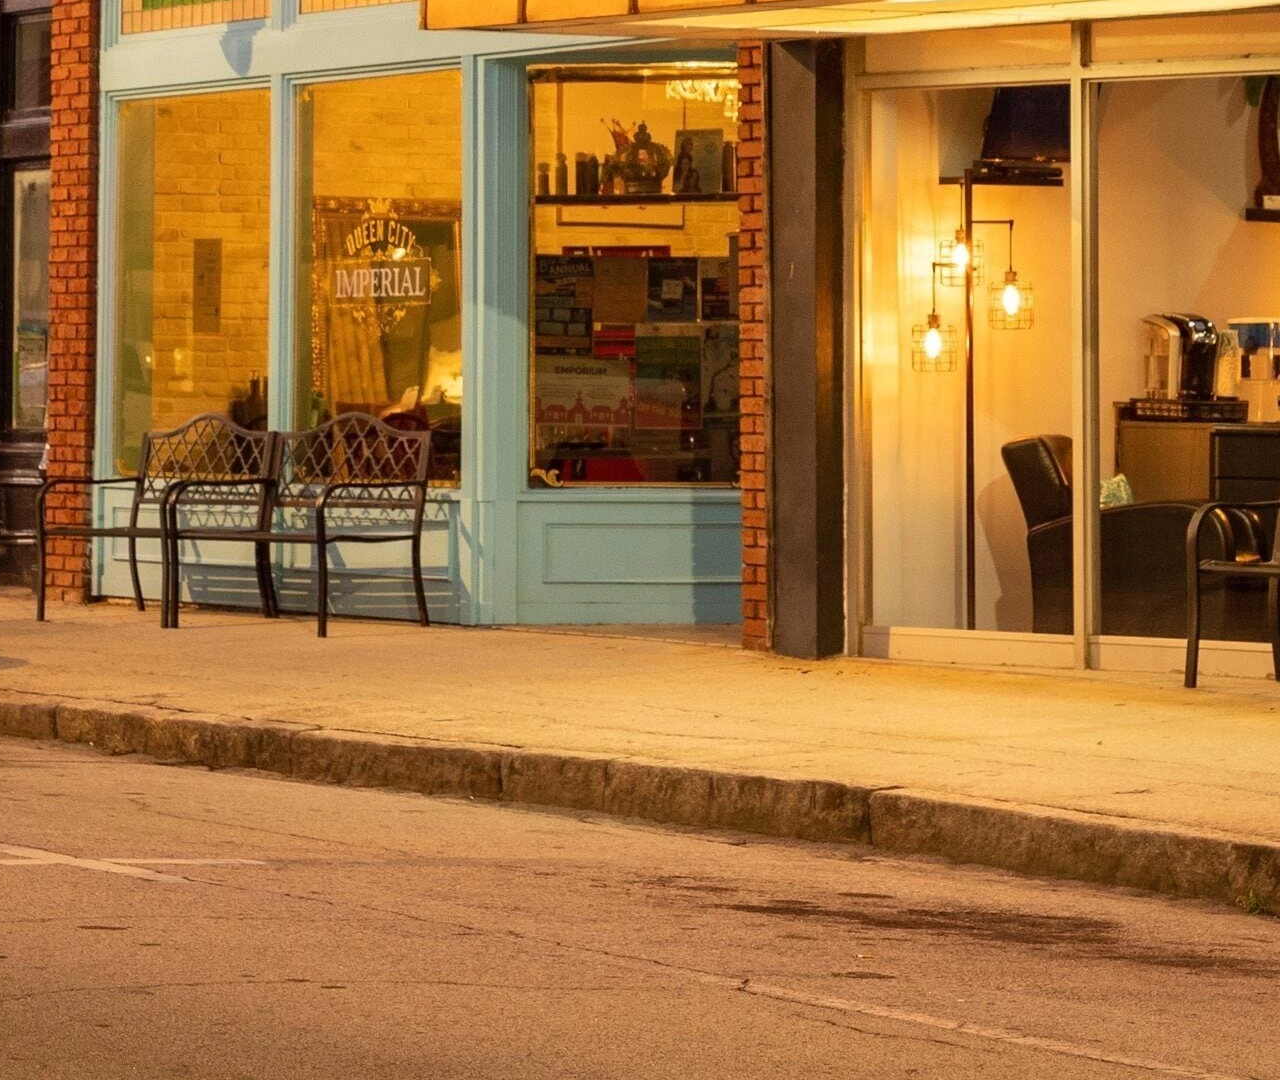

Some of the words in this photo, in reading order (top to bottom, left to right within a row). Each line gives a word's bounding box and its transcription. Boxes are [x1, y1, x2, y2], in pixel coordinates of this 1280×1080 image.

[346, 220, 384, 256] QUEEN
[388, 221, 416, 255] CITY
[335, 267, 426, 299] IMPERIAL
[554, 366, 608, 375] EMPORIUM
